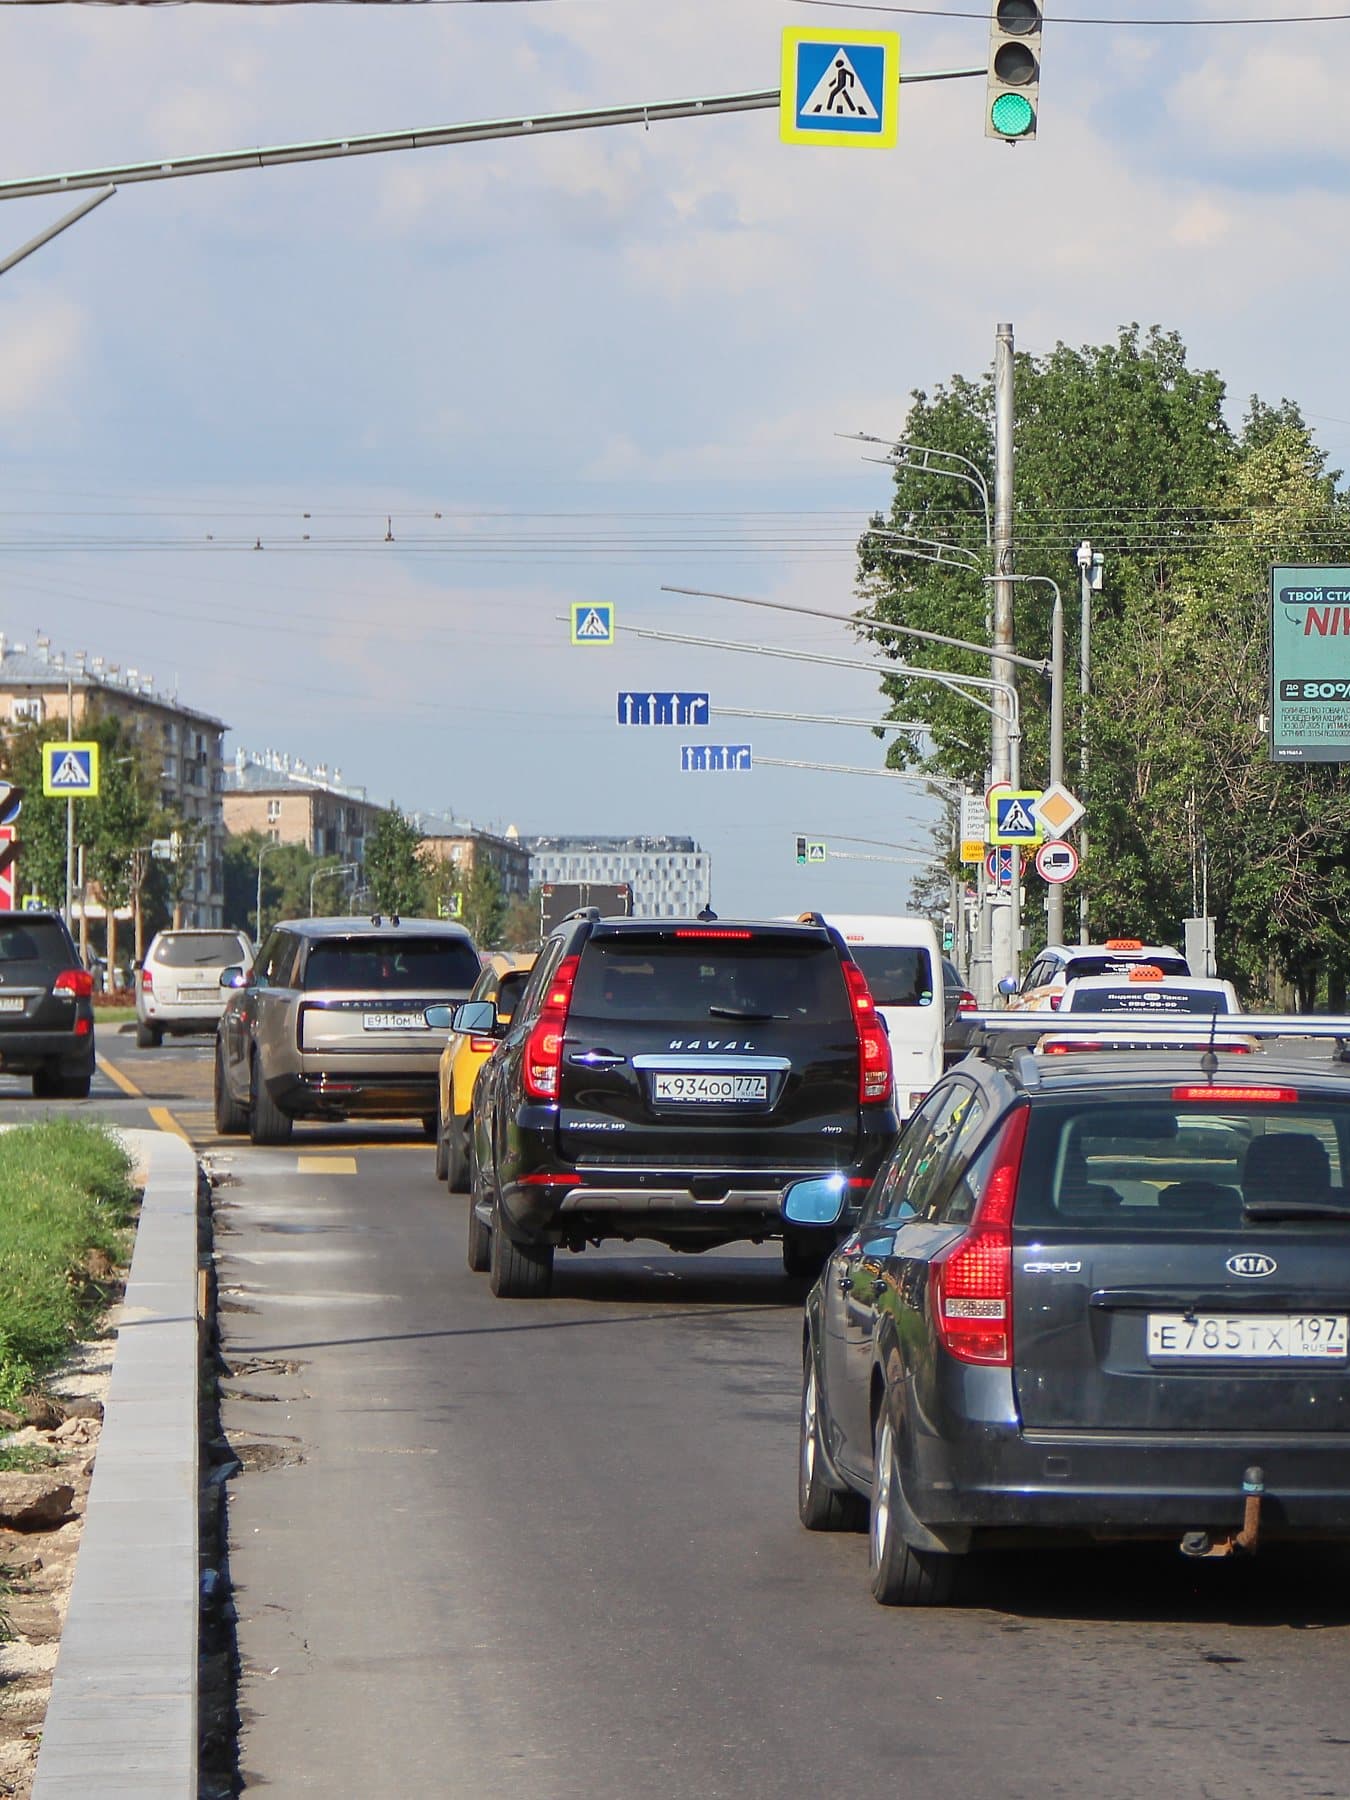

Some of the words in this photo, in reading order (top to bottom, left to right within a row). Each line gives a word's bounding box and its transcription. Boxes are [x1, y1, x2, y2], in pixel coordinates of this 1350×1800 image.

[1287, 587, 1323, 601] ТВОЙ
[669, 1040, 756, 1050] HAVAL
[1235, 1258, 1269, 1272] KIA
[1294, 1317, 1337, 1342] 197
